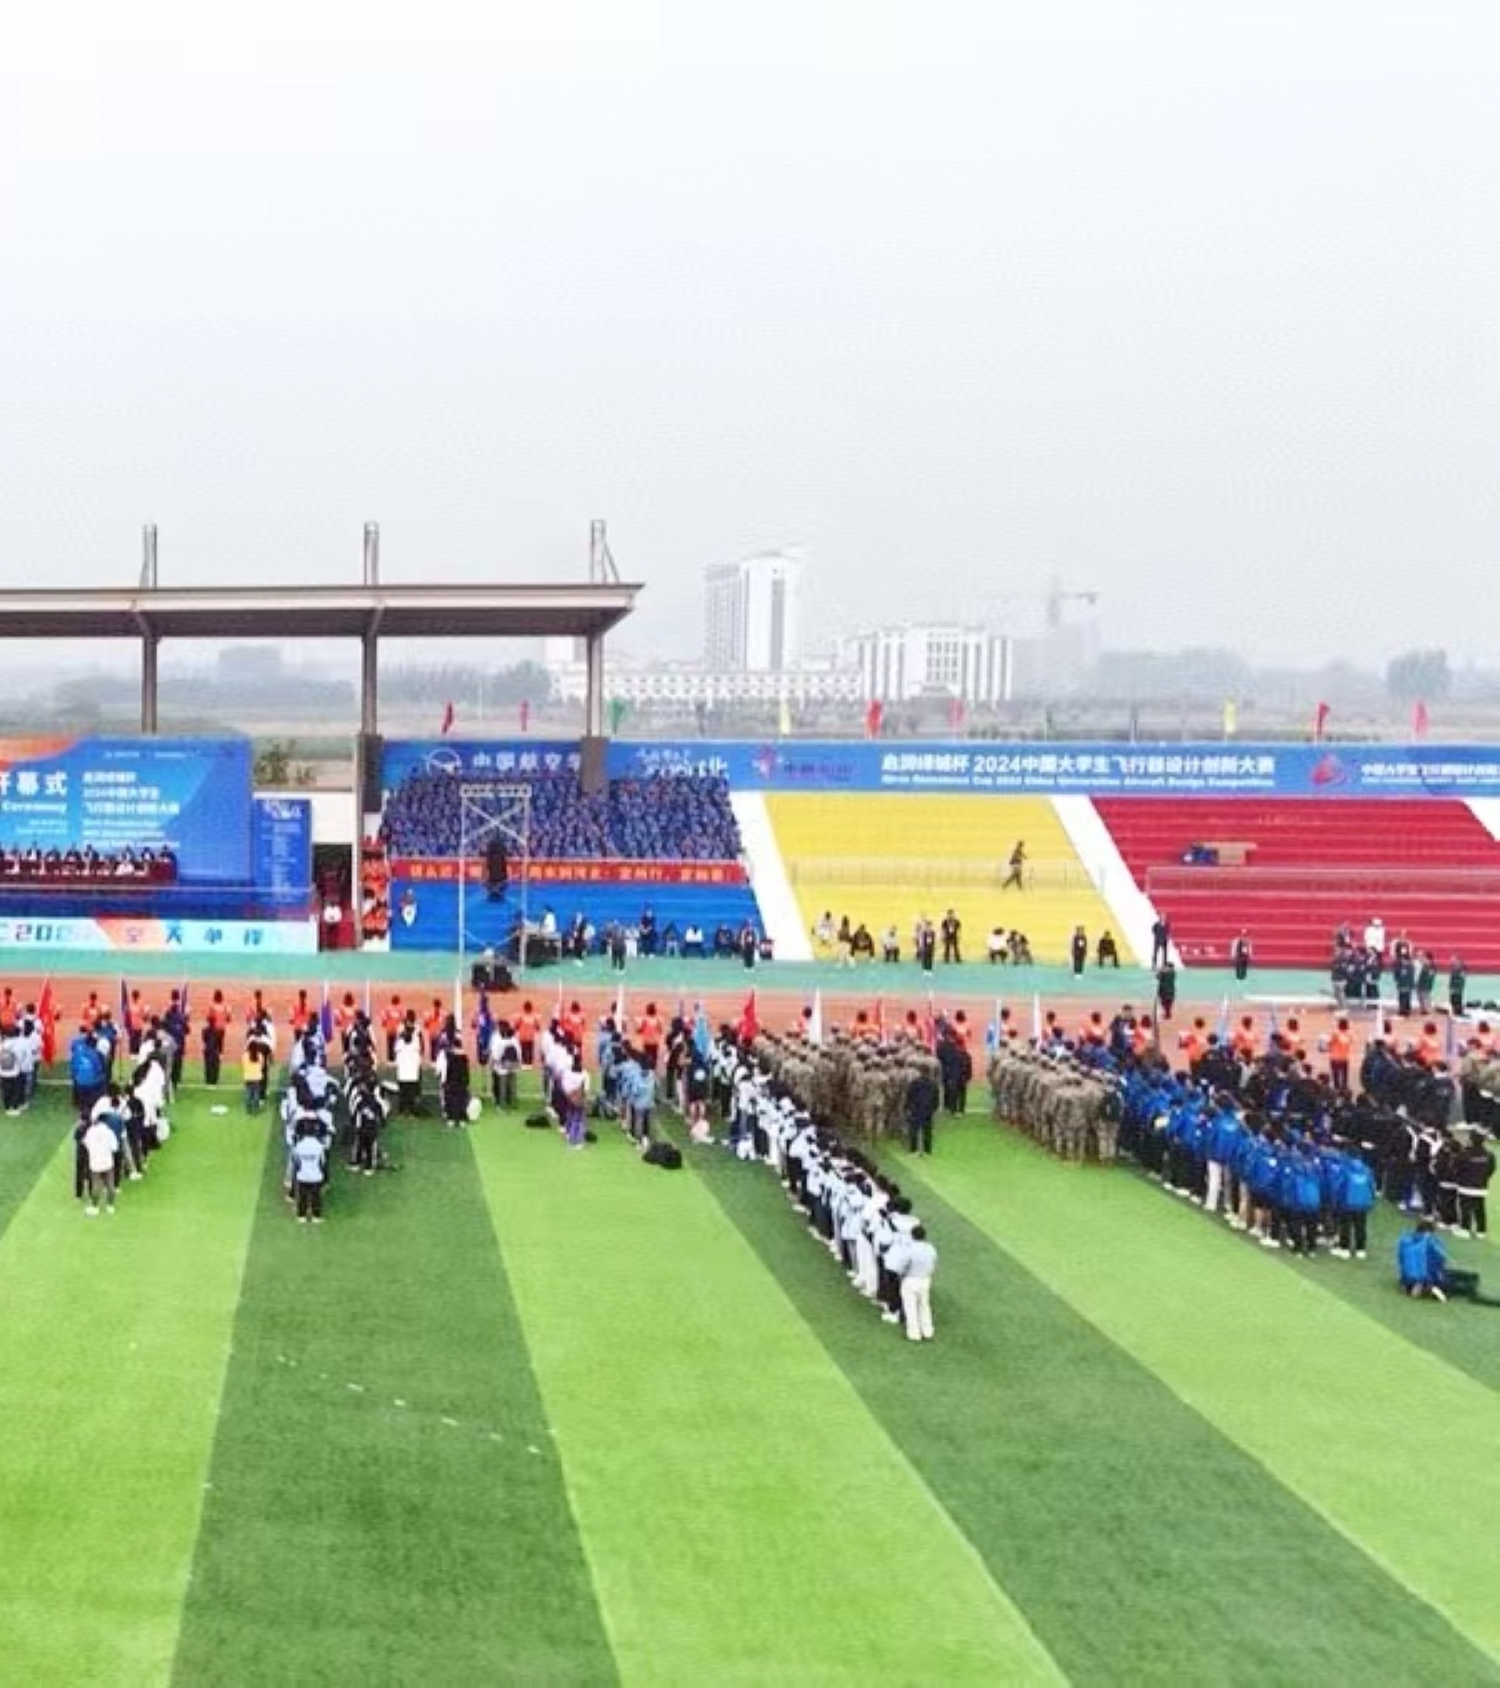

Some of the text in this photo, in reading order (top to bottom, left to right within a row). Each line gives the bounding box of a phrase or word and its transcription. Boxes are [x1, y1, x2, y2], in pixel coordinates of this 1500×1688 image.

[973, 754, 1275, 774] 2024中国大学生飞行器设计创新大赛
